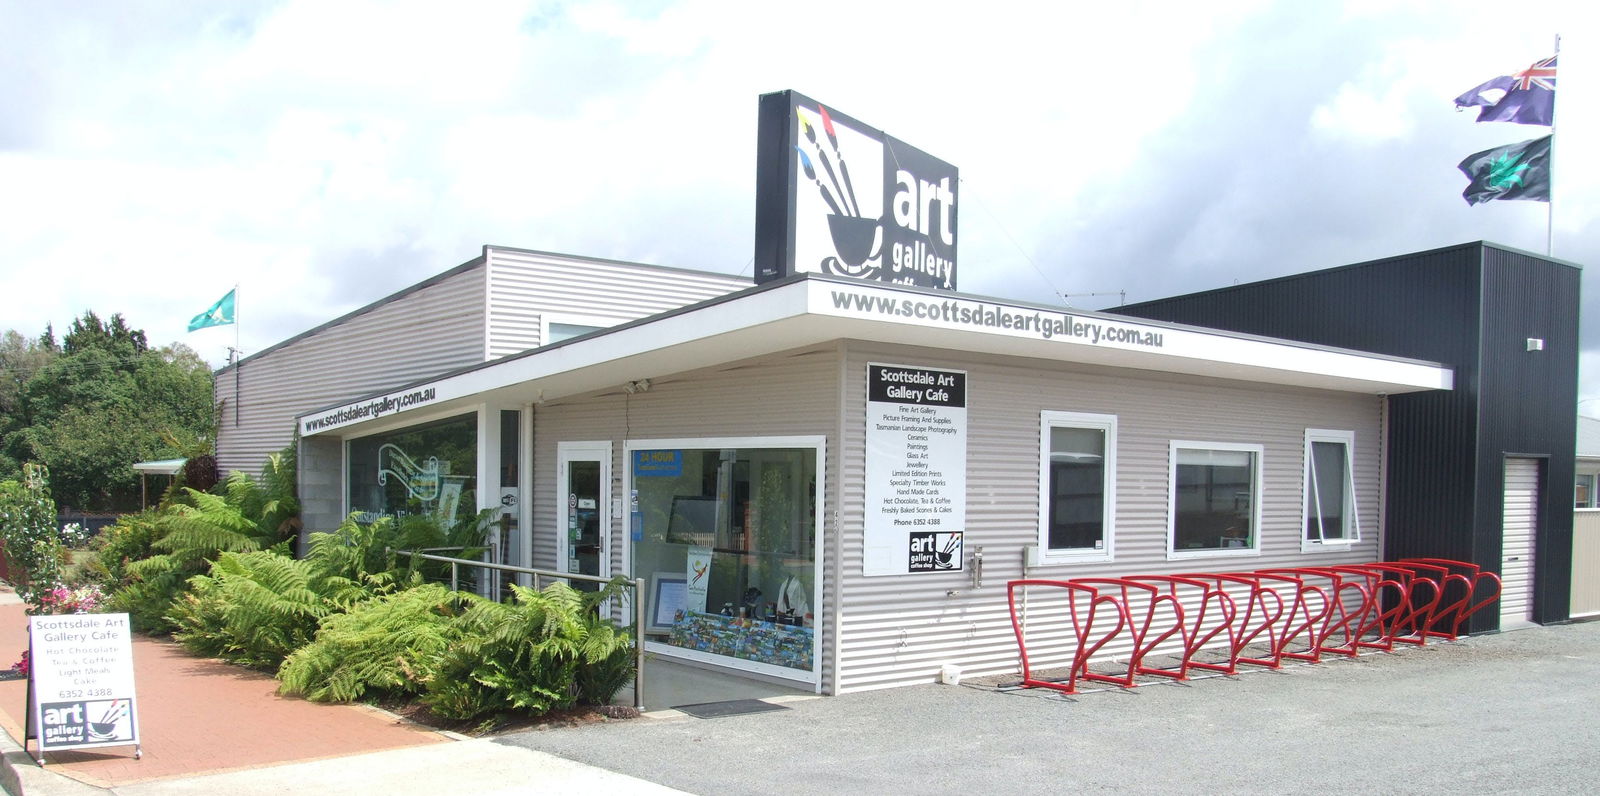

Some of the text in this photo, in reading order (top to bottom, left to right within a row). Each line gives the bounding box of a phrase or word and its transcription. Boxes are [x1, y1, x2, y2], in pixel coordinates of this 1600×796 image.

[893, 169, 954, 245] art
[892, 240, 953, 288] gallery
[831, 290, 1163, 347] www.scottsdaleartgallery.com.au
[881, 369, 954, 386] Scottsdale Art
[887, 386, 949, 402] Gallery Cafe
[305, 388, 436, 432] www.scottsdaleartgallery.com.au
[920, 407, 936, 415] Gallery
[933, 417, 951, 425] Supplies
[902, 425, 927, 433] Landscape
[928, 426, 957, 434] Photography
[907, 443, 928, 451] Paintings
[911, 534, 934, 552] art
[911, 553, 934, 563] gallery
[36, 619, 124, 629] Scottsdale Art
[44, 630, 119, 643] Gallery Cafe
[69, 646, 119, 654] Chocolate
[60, 667, 111, 677] Light Meals
[59, 688, 113, 698] 6352 4388
[44, 704, 83, 725] art
[46, 725, 84, 737] gallery
